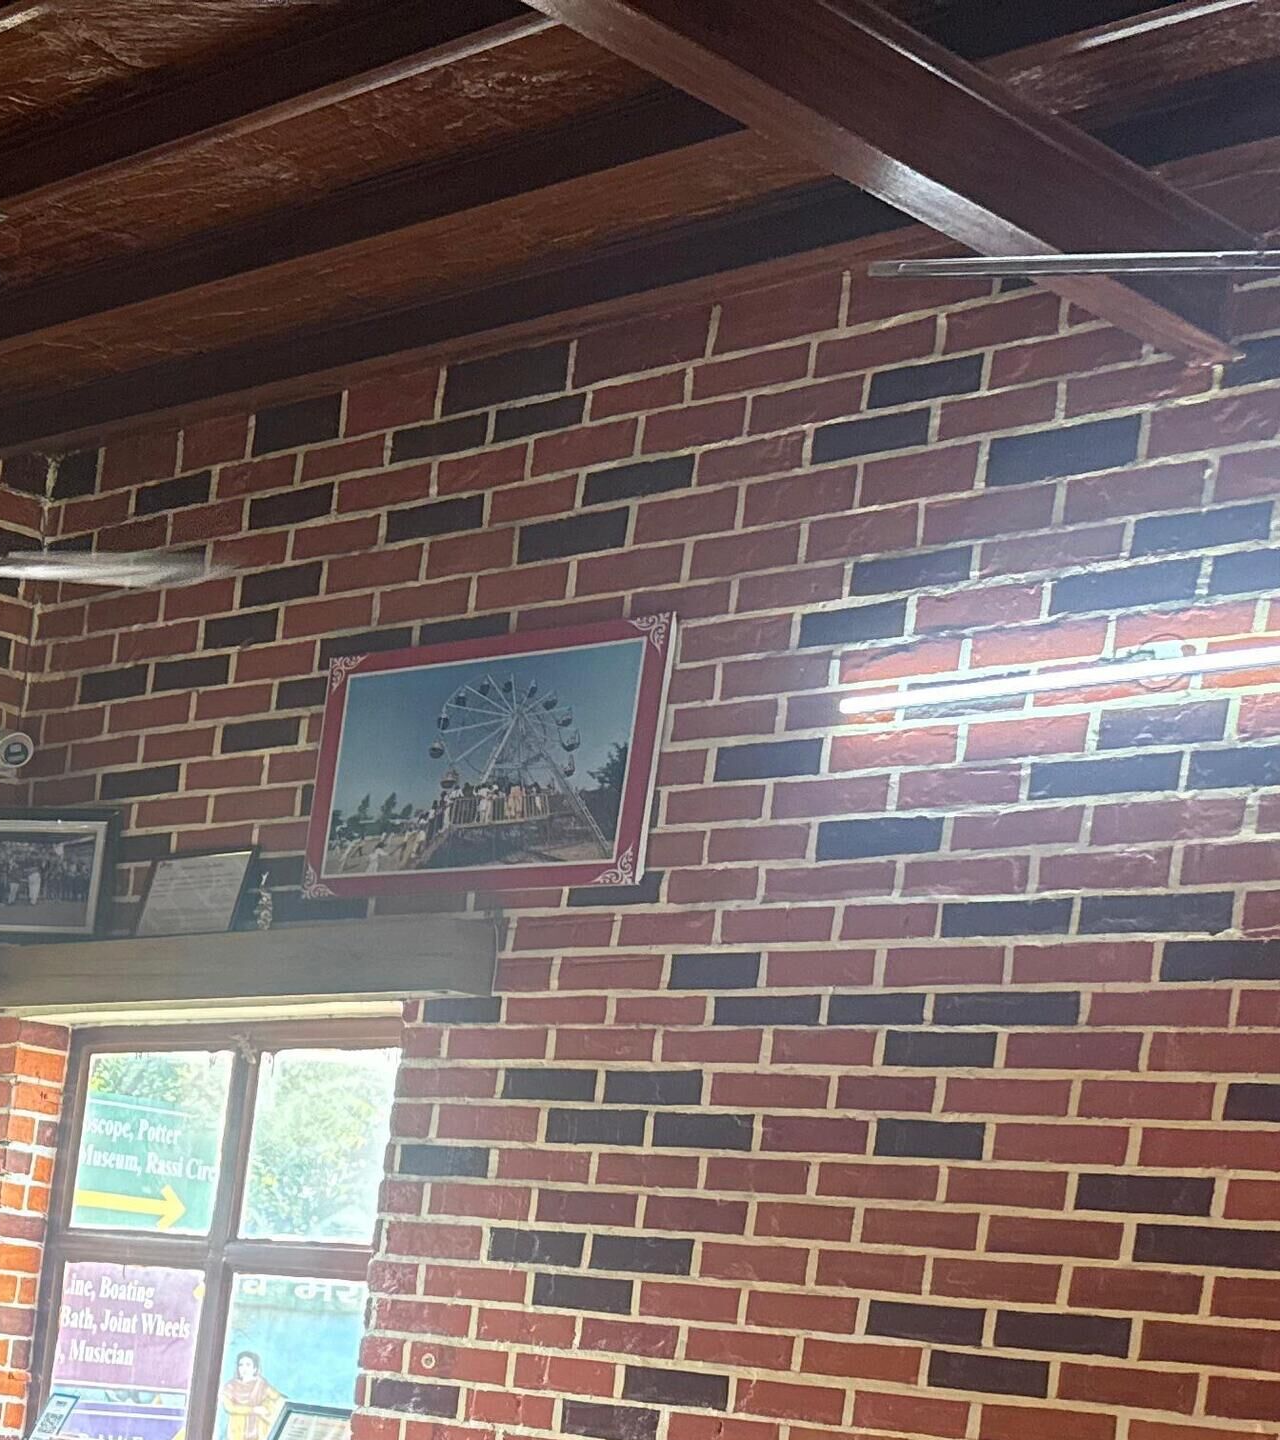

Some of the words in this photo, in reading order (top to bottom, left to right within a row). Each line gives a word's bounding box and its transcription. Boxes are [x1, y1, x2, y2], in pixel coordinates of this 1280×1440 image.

[137, 1119, 183, 1145] Potter
[99, 1276, 155, 1309] Boating
[100, 1309, 138, 1334] Joint
[140, 1312, 191, 1339] Wheels
[69, 1339, 134, 1366] Musician
